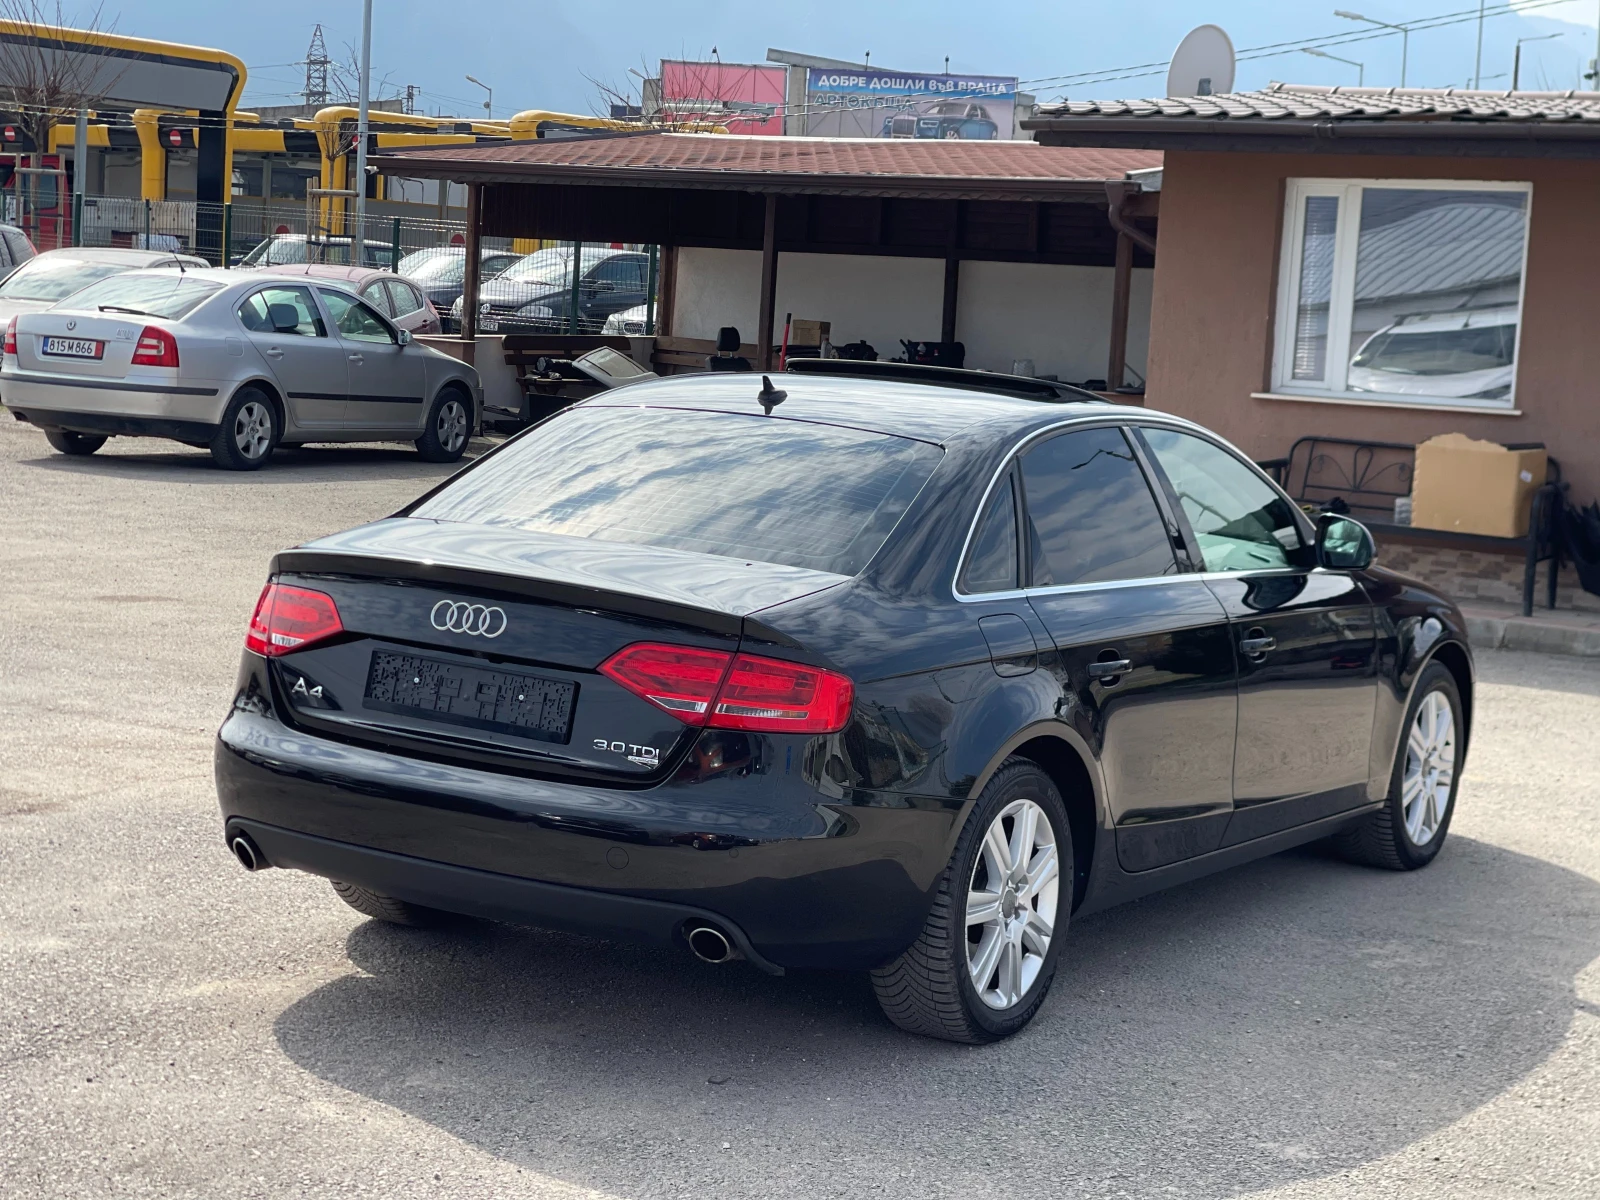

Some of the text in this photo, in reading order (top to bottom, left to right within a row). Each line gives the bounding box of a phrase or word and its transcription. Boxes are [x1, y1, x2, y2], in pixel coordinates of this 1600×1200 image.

[818, 75, 866, 87] ДОБРЕ
[870, 77, 925, 89] ДОШЛИ
[958, 81, 1007, 94] ВРАЦА
[814, 93, 915, 112] АВТОКЪЩА
[291, 676, 323, 699] A4
[593, 739, 659, 759] 3.0 TDI
[1047, 787, 1069, 836] KUMHO
